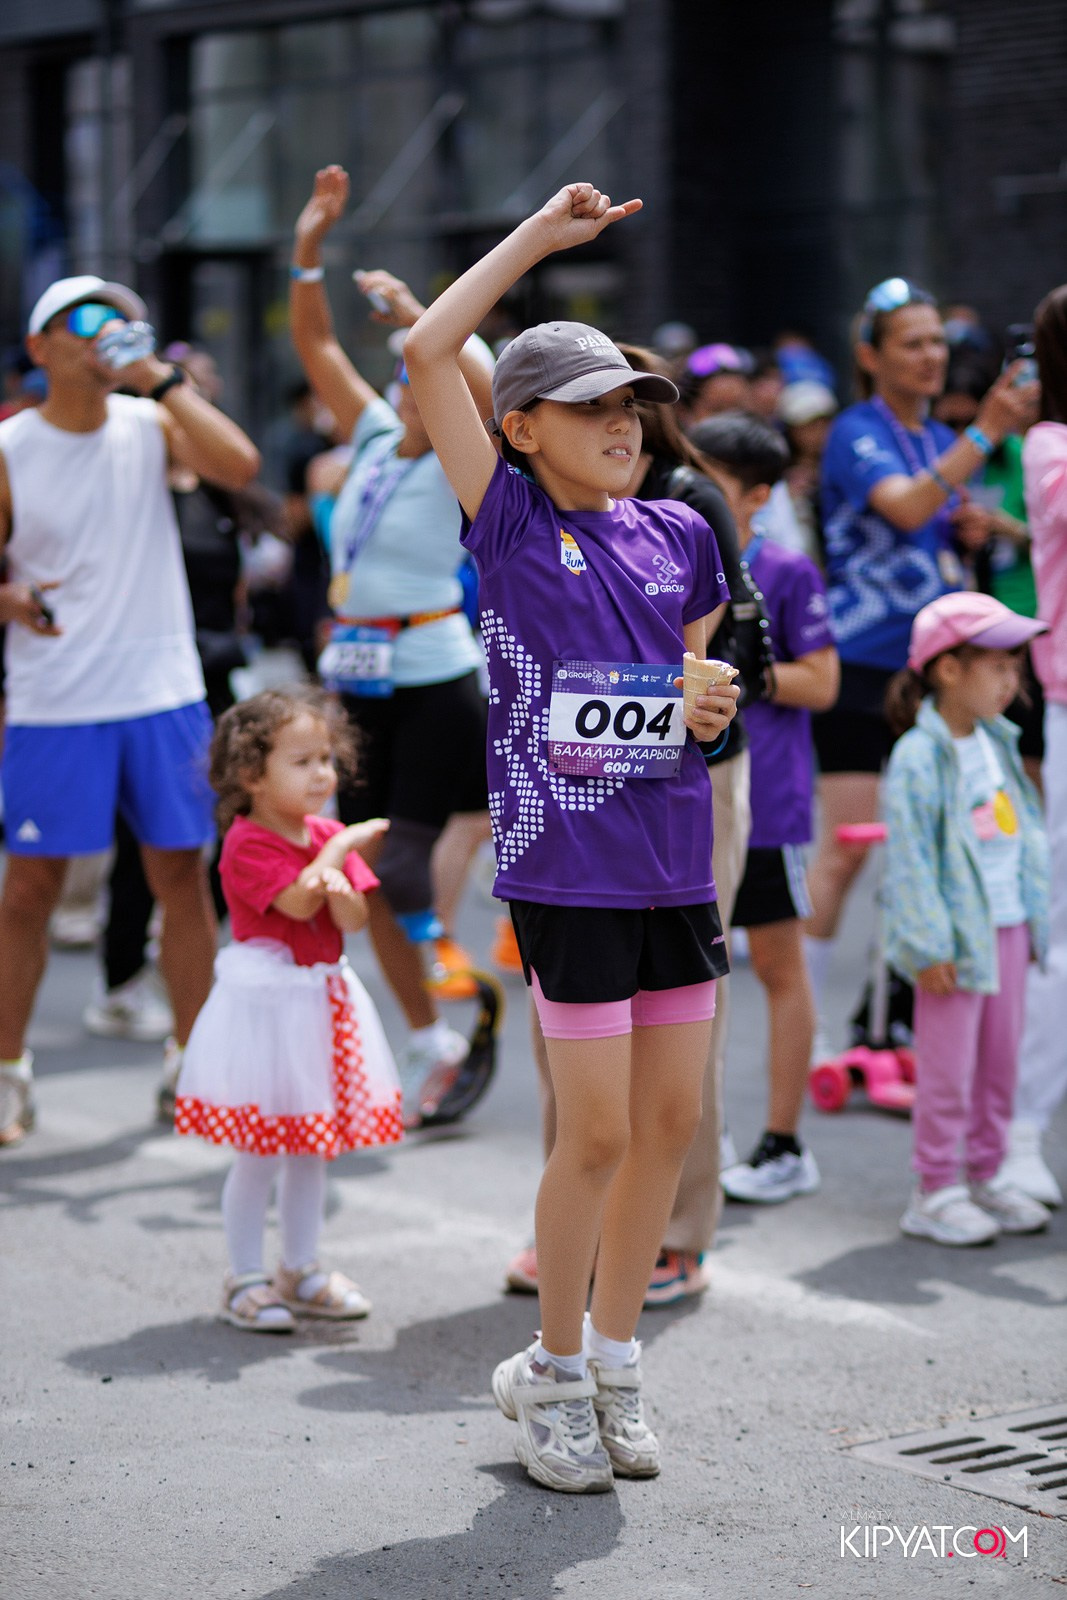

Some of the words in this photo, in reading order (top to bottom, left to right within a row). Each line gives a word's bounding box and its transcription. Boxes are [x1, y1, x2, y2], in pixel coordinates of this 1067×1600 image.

[566, 558, 585, 568] RUN
[646, 584, 658, 594] BI
[660, 584, 685, 593] GROUP
[568, 671, 592, 679] GROUP
[575, 700, 675, 741] 004
[553, 744, 624, 759] БАЛАЛАР
[624, 747, 680, 760] ЖАРЫСЫ
[603, 762, 631, 774] 600
